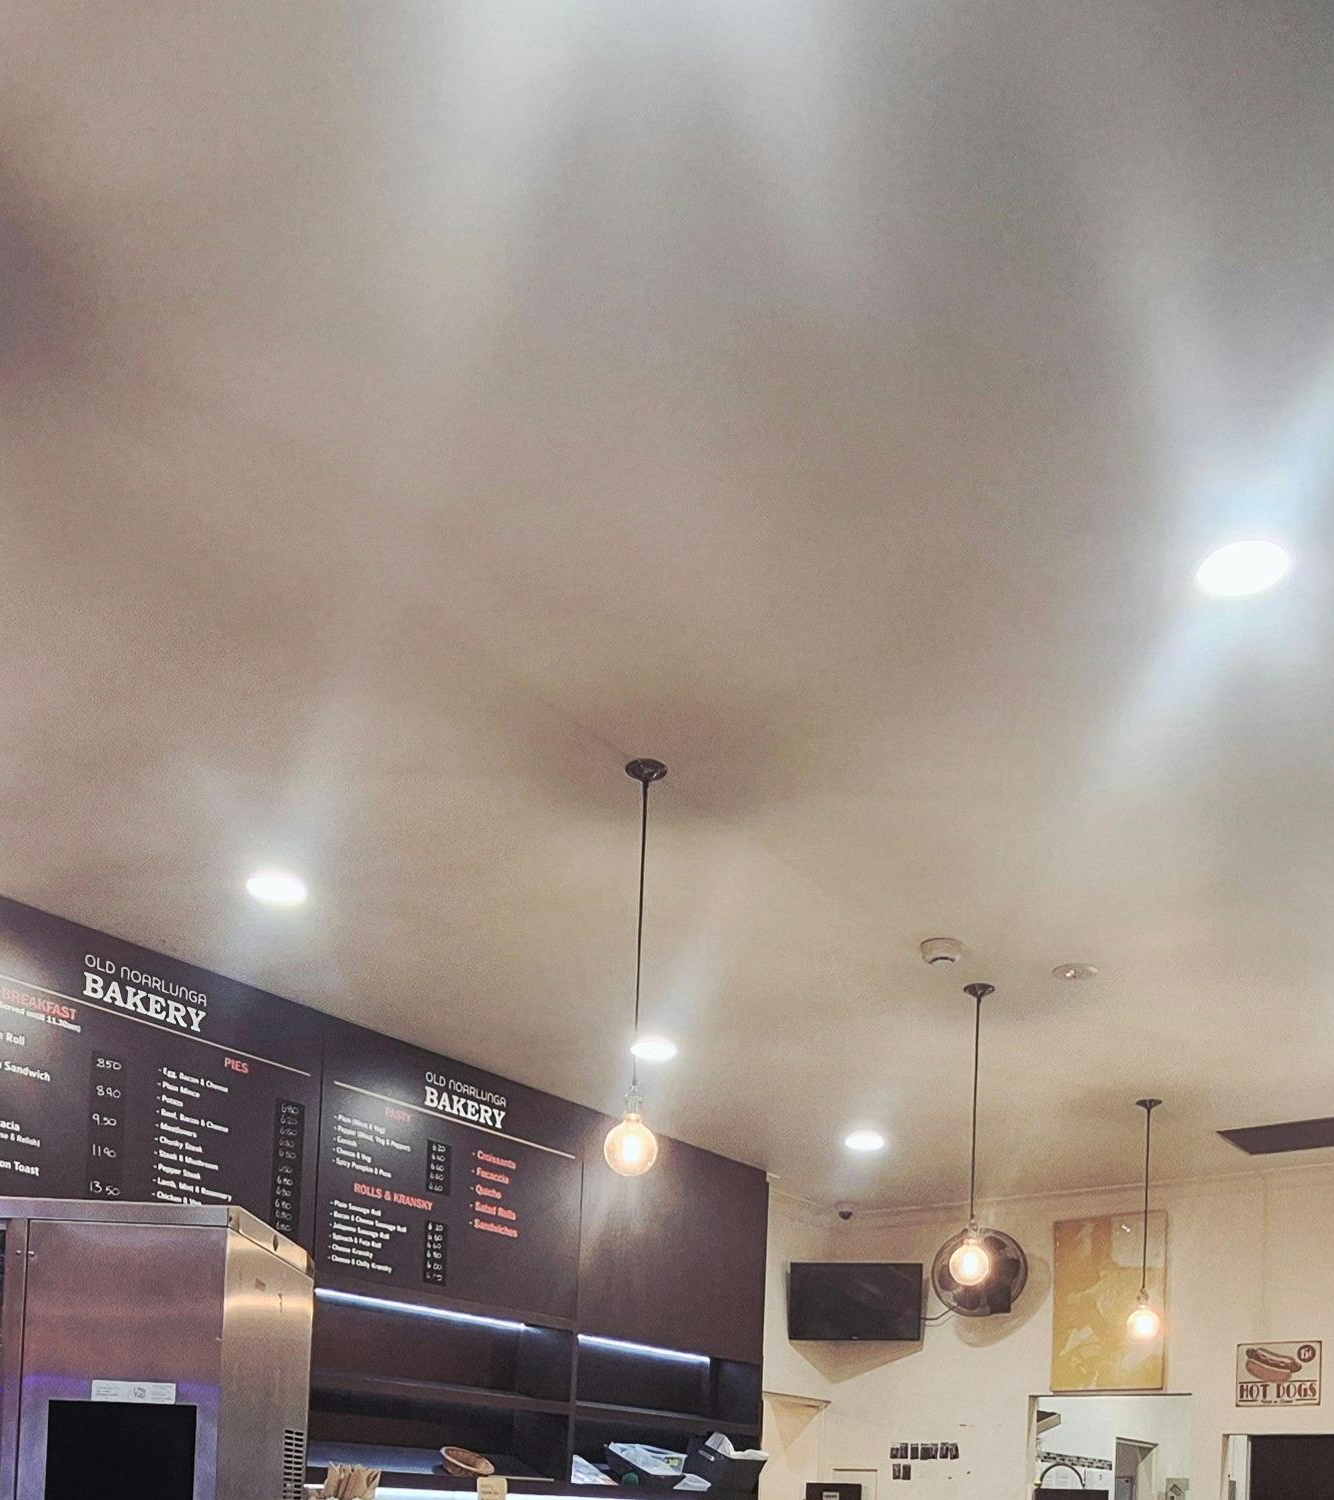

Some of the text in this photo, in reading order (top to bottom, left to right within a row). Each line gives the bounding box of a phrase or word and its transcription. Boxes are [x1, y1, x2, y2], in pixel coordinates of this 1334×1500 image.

[84, 953, 207, 1007] OLD NOARLUNGA
[0, 987, 78, 1021] BREAKFAST
[82, 971, 207, 1032] BAKERY
[5, 1031, 26, 1046] Roll
[3, 1061, 51, 1082] Sandwich
[223, 1056, 250, 1075] PIES
[425, 1071, 507, 1108] OLD NOARLUNGA
[424, 1085, 507, 1130] BAKERY
[13, 1161, 41, 1177] Toast
[476, 1150, 516, 1170] Croissants
[353, 1183, 433, 1212] ROLLS & KRANSKY
[475, 1184, 503, 1200] Quiche
[473, 1218, 518, 1239] Sandwiches
[1239, 1383, 1318, 1399] HOT DOGS
